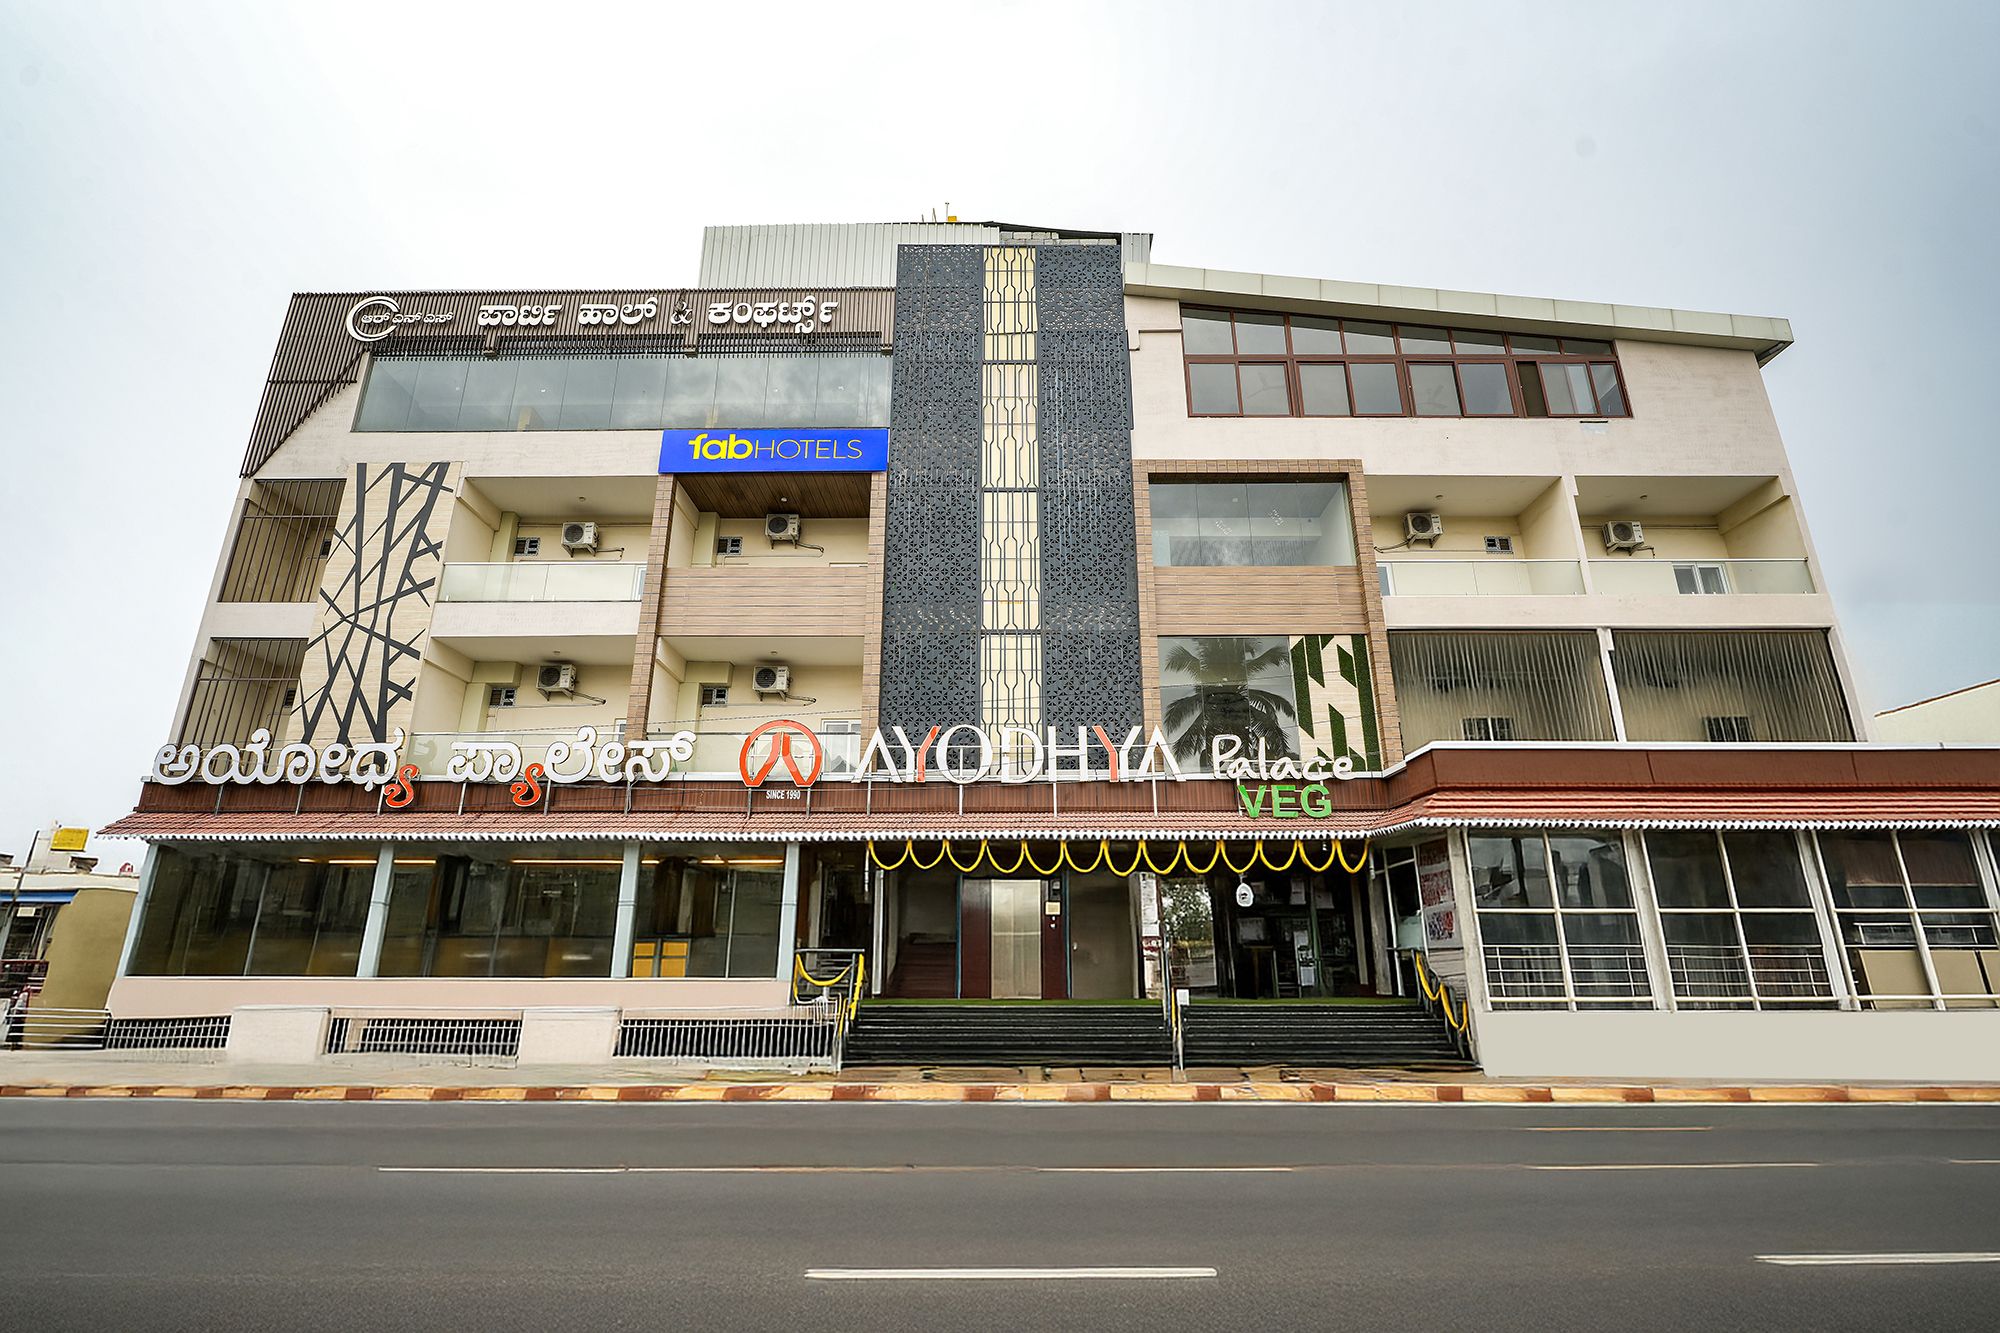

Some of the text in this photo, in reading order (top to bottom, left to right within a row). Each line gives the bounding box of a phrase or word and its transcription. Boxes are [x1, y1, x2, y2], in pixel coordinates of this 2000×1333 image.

[392, 312, 422, 324] ಎನ್
[477, 304, 563, 326] ಪಾರ್ಟಿ
[577, 296, 658, 325] ಹಾಲ್
[670, 300, 693, 325] &
[152, 725, 698, 808] ಅಯೋಧ್ಯ ಪ್ಯಾಲೇಸ್
[851, 724, 1356, 784] AYODHYA Palace
[765, 790, 801, 800] SINCE 1990
[1237, 784, 1332, 818] VEG
